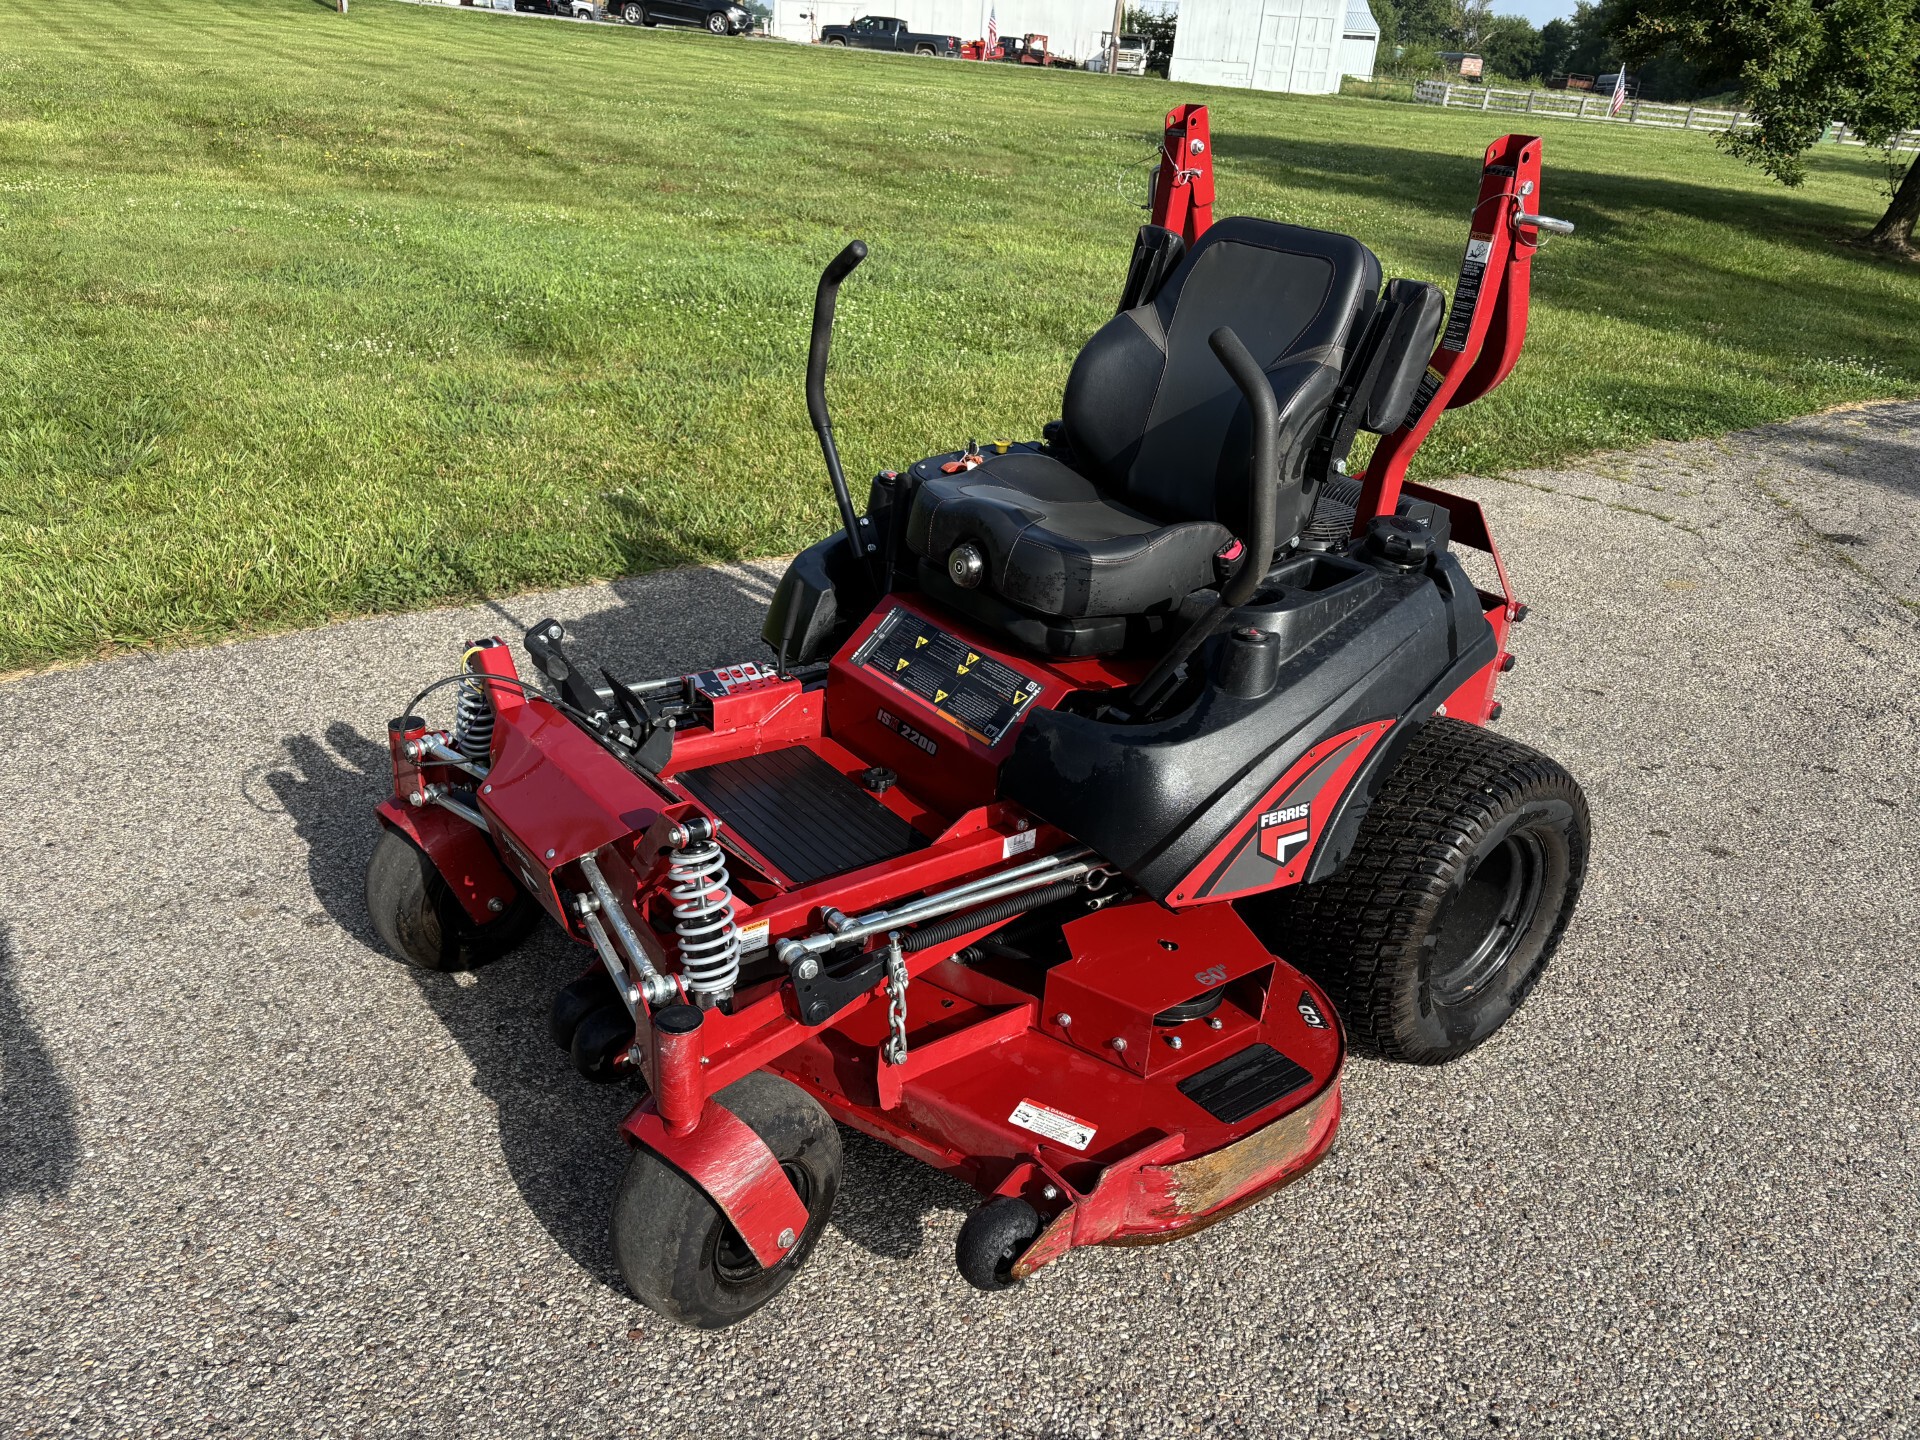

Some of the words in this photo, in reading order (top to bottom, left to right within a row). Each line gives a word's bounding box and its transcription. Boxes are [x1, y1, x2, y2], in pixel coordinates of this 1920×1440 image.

[900, 724, 938, 755] 2200
[1261, 803, 1309, 828] FERRIS
[1194, 963, 1227, 986] 60"
[1050, 1108, 1076, 1121] DANGER
